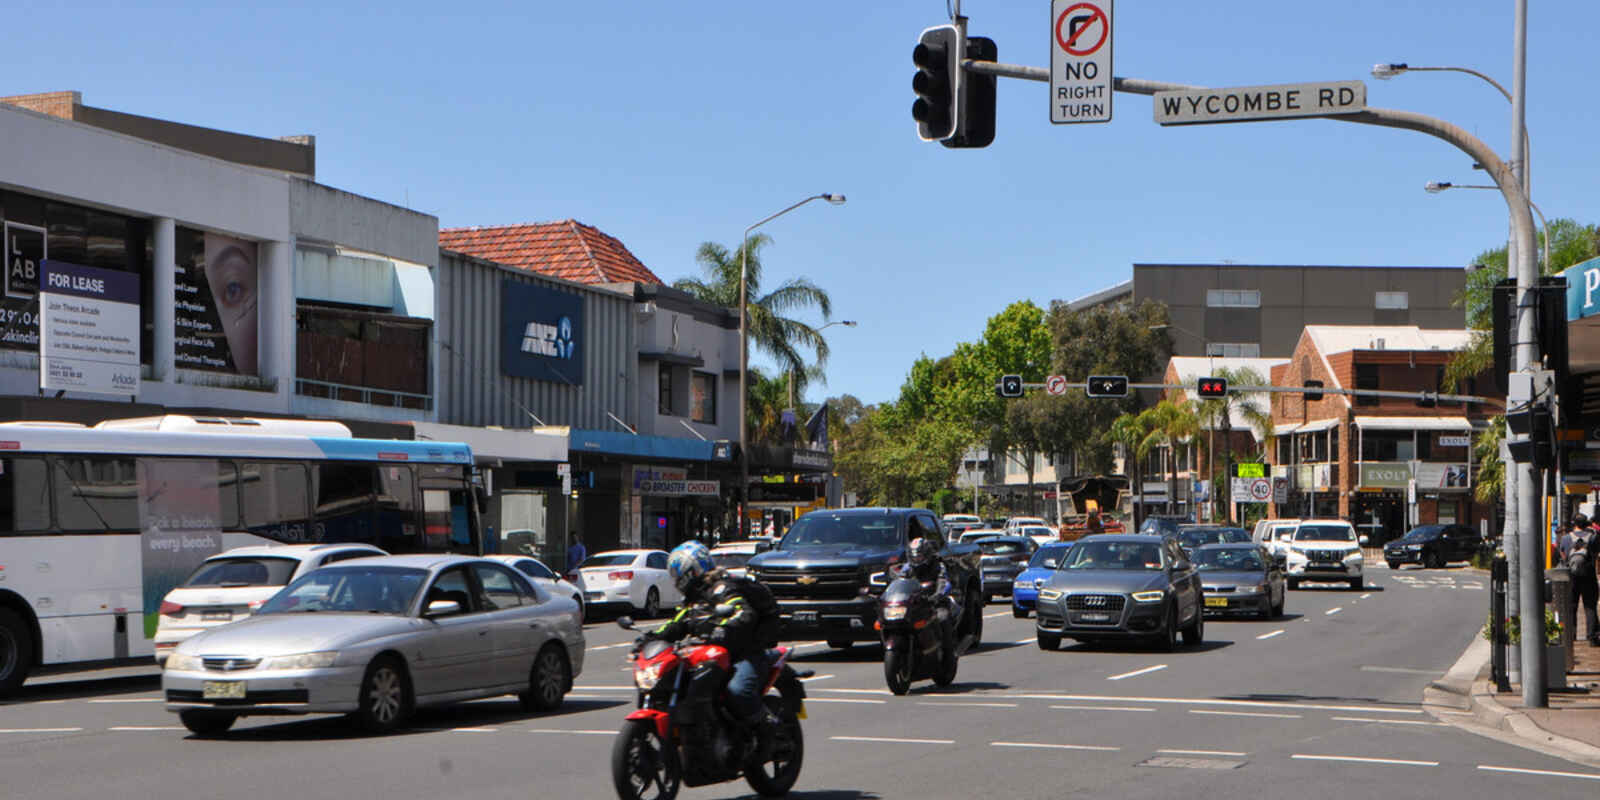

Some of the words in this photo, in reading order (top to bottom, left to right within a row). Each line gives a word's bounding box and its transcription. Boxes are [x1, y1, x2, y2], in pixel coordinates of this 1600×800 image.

[1066, 63, 1098, 80] NO
[1058, 86, 1105, 98] RIGHT
[1163, 91, 1300, 115] WYCOMBE
[1318, 88, 1354, 107] RD
[1060, 104, 1104, 117] TURN
[12, 235, 22, 255] L
[12, 258, 35, 279] AB
[48, 272, 70, 288] FOR
[72, 276, 104, 293] LEASE
[521, 322, 558, 357] ANZ
[1368, 470, 1408, 481] EXOLT
[688, 483, 717, 493] CHICKEN
[1254, 484, 1268, 495] 40
[151, 539, 181, 553] every
